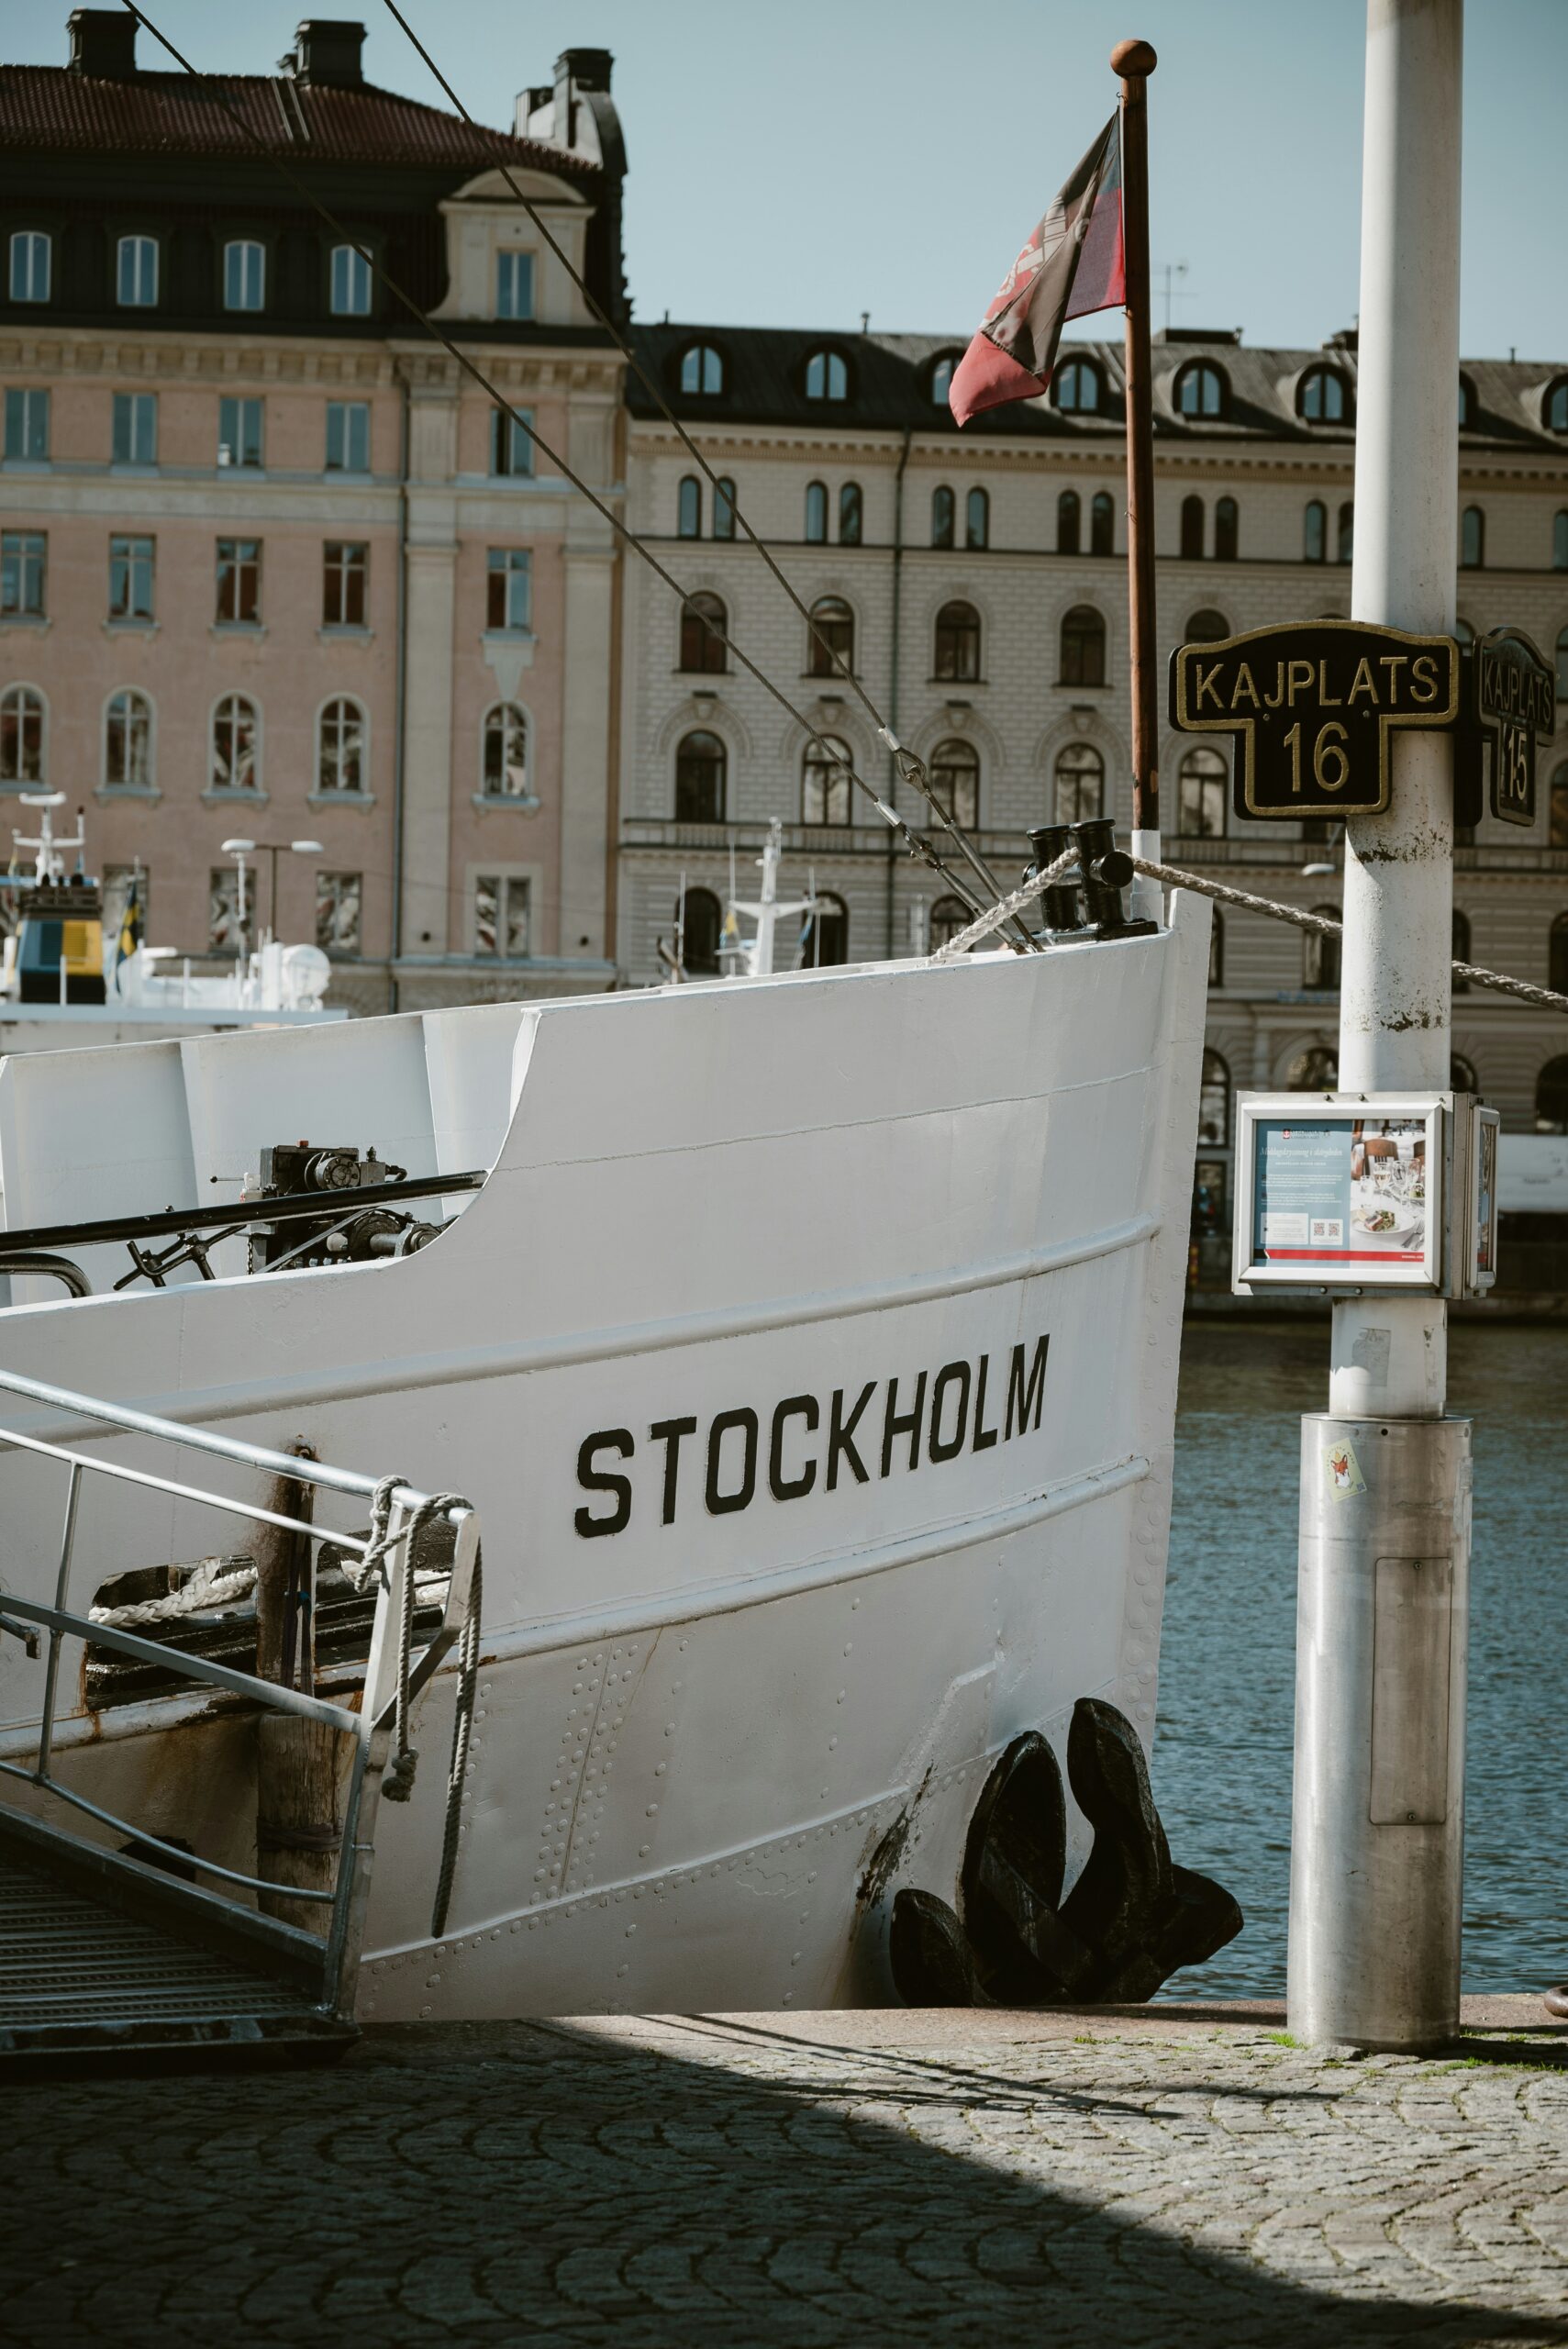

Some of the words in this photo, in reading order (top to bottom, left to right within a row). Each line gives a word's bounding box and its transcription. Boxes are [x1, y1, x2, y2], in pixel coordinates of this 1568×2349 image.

[1195, 655, 1440, 711] KAJPLATS
[1484, 659, 1552, 723] KAJPLATS
[1283, 721, 1350, 793] 16
[1508, 728, 1528, 800] 15
[574, 1333, 1051, 1539] STOCKHOLM
